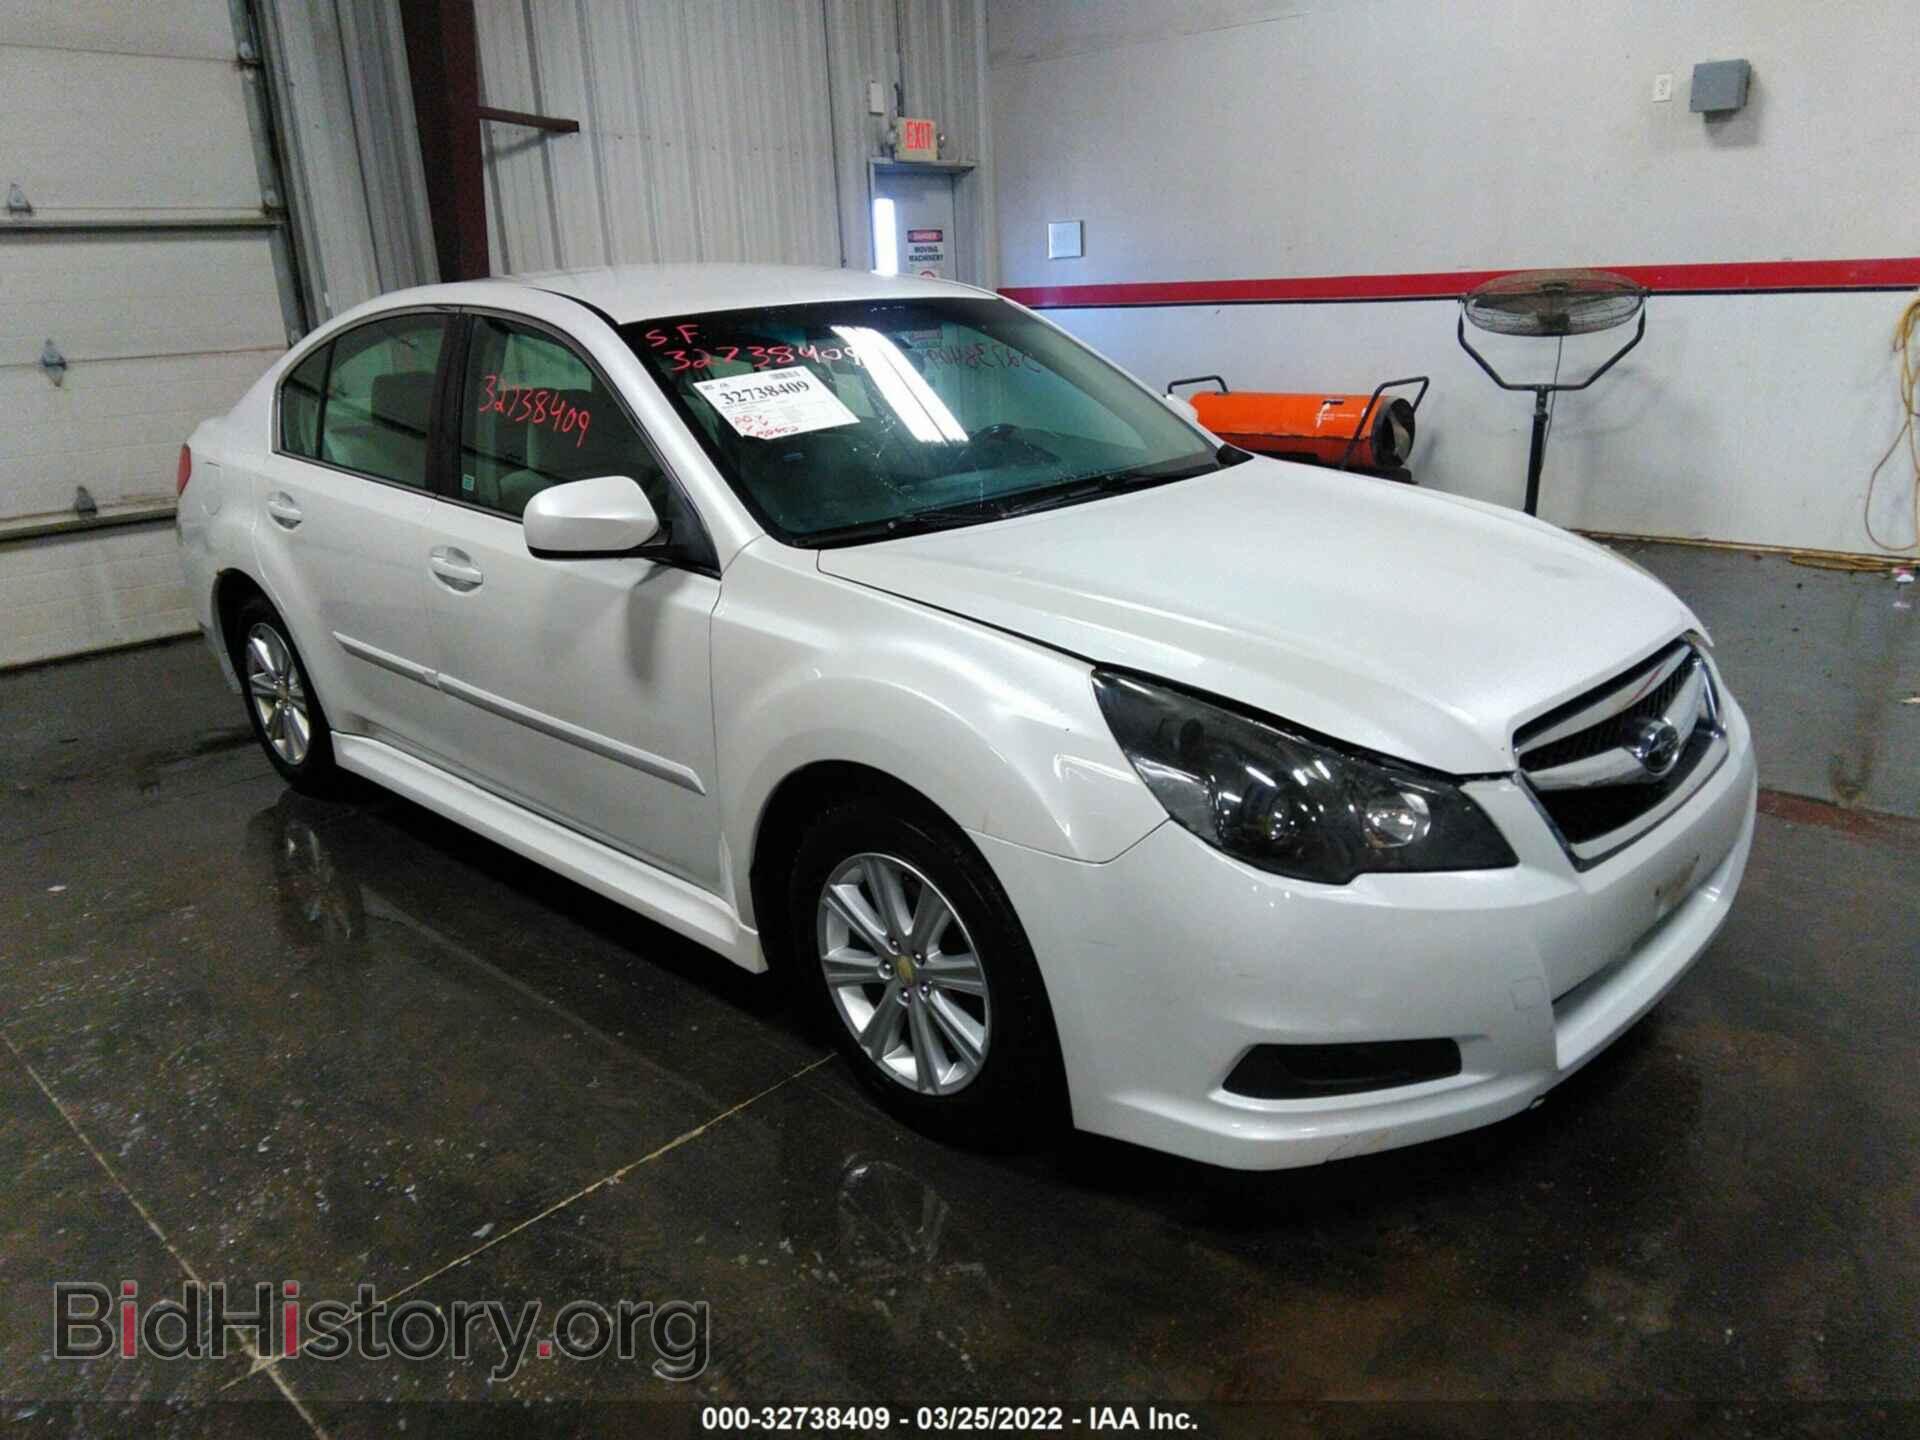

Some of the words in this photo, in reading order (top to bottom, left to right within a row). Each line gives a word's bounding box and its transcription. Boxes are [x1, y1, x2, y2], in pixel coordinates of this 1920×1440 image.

[906, 120, 933, 149] EXIT
[720, 380, 810, 405] 32738409
[479, 373, 590, 448] 32738409
